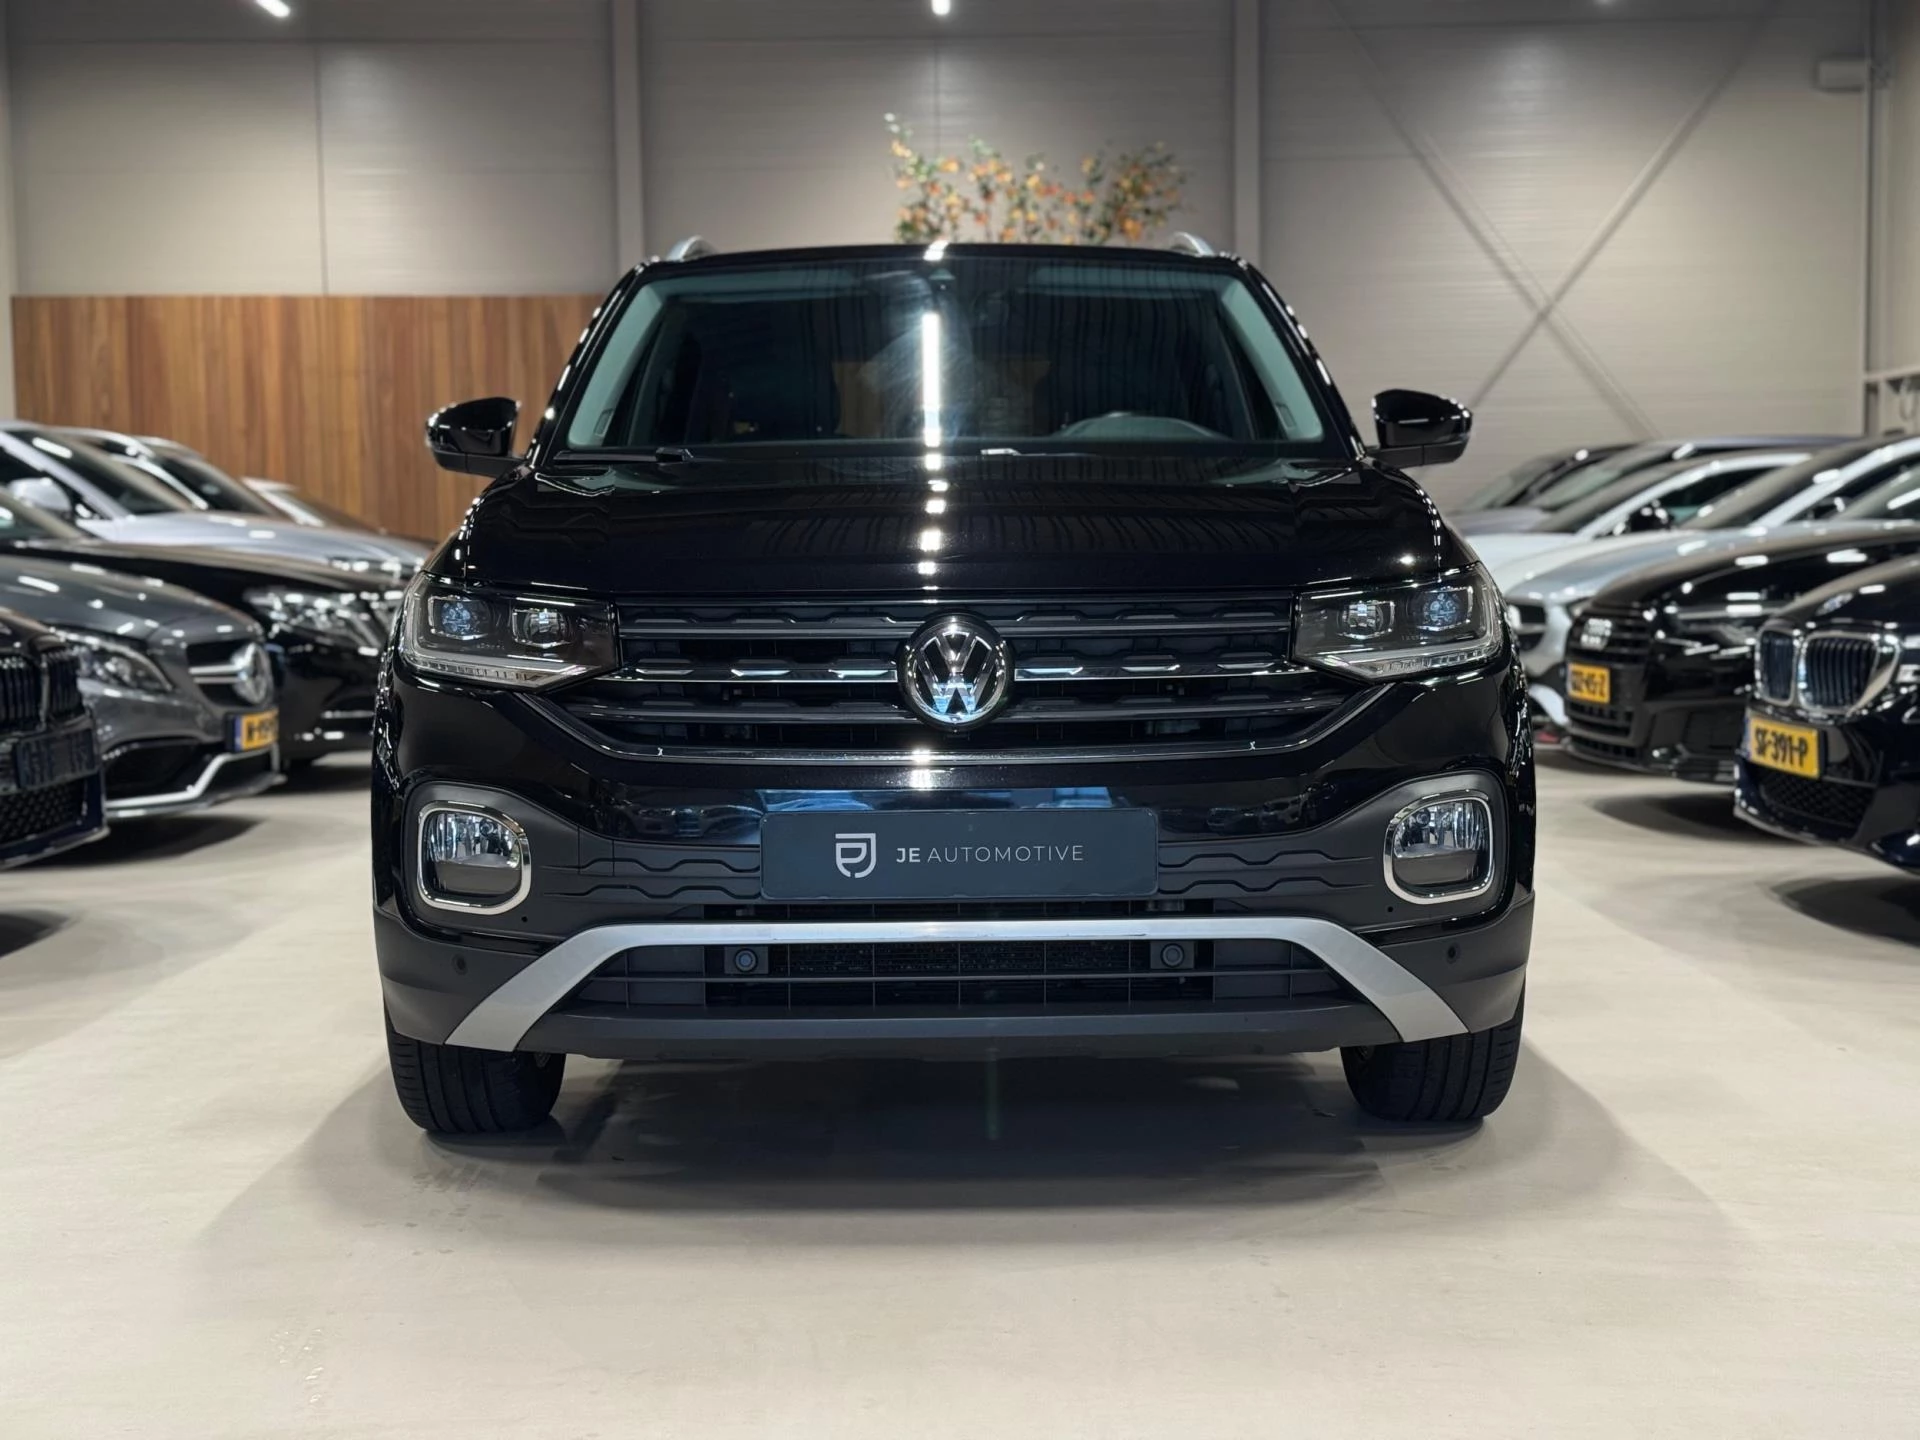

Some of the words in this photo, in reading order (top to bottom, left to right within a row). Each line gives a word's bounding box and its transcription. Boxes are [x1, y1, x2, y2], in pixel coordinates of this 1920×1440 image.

[917, 629, 999, 718] VW
[896, 847, 921, 864] JE
[927, 844, 1084, 863] AUTOMOTIVE
